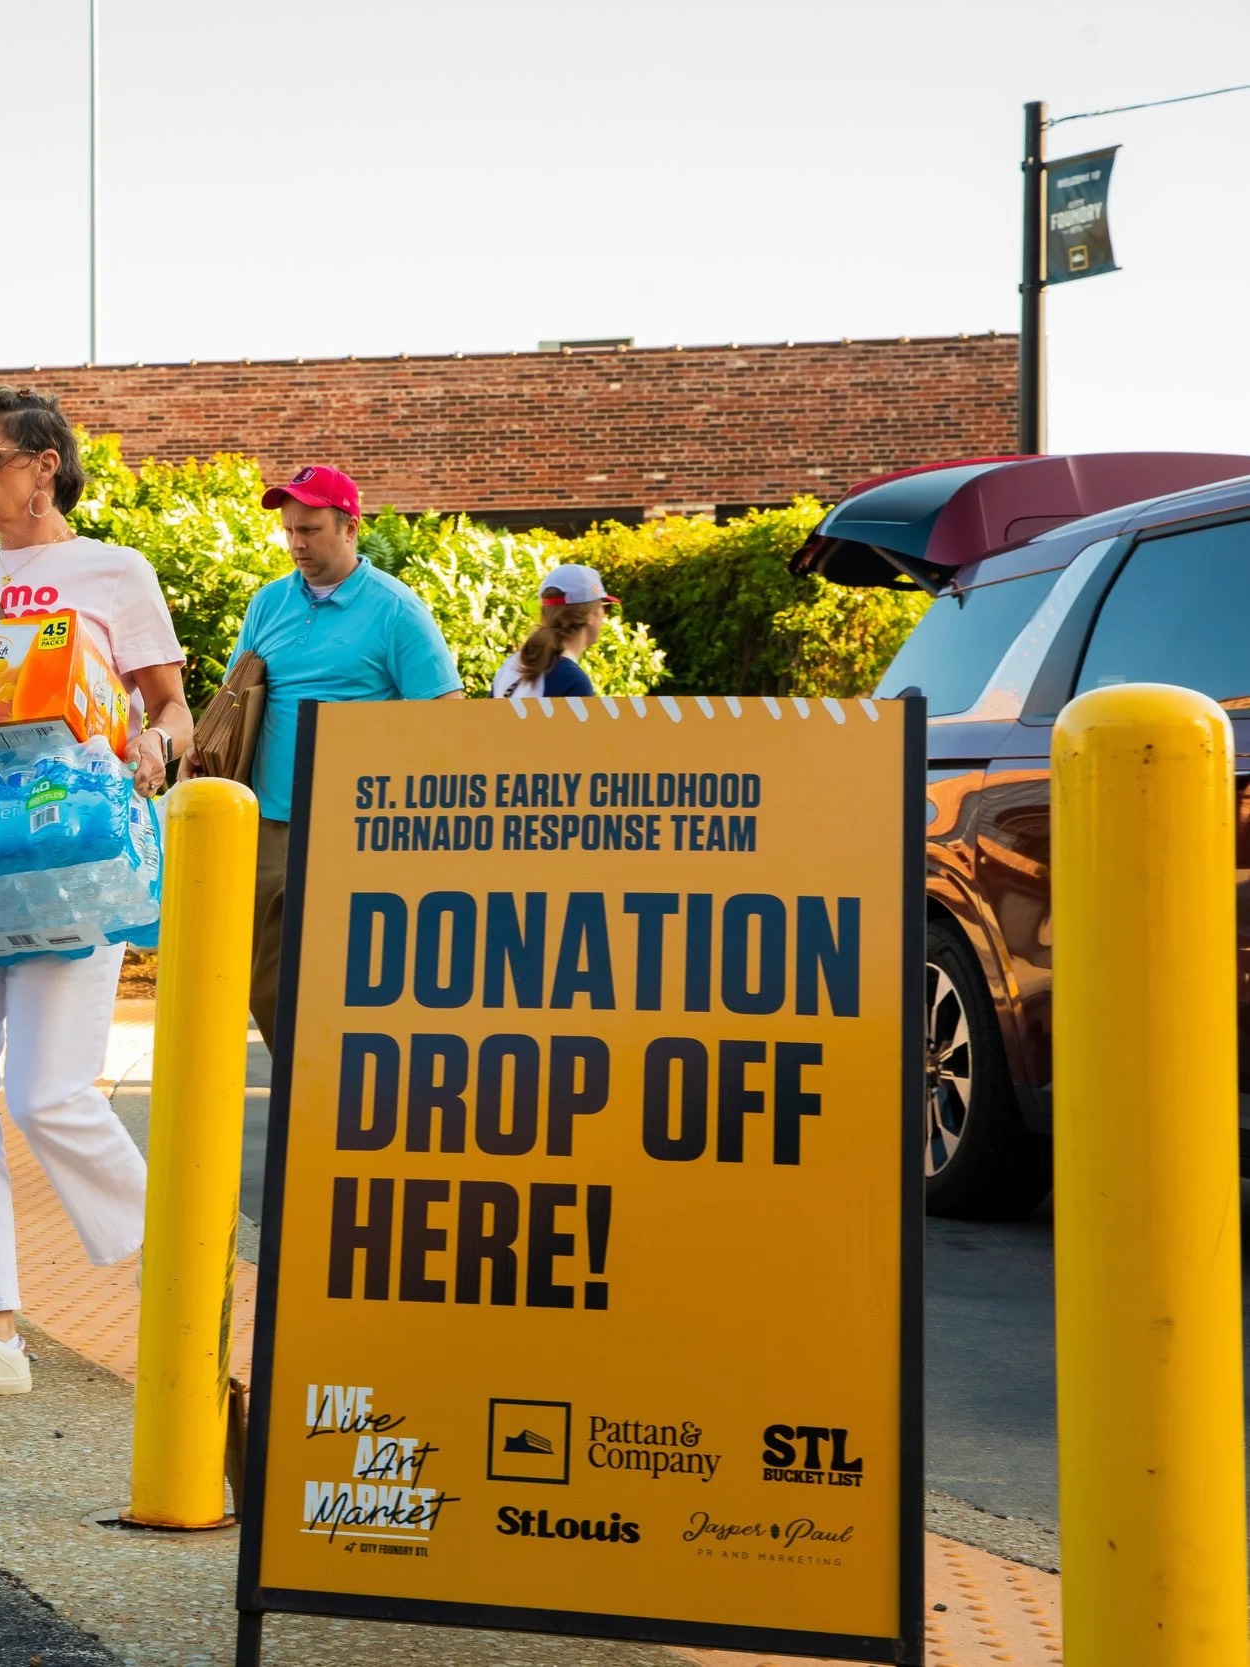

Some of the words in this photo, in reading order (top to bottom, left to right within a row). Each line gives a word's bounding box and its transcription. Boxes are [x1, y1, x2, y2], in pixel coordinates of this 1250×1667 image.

[43, 621, 67, 636] 45
[31, 780, 50, 795] 40
[356, 775, 397, 810] ST.
[405, 774, 487, 809] LOUIS
[495, 773, 582, 808] EARLY
[589, 773, 761, 808] CHILDHOOD
[355, 816, 494, 852] TORNADO
[503, 815, 660, 852] RESPONSE
[671, 816, 757, 852] TEAM
[344, 890, 861, 1018] DONATION
[336, 1032, 610, 1157] DROP
[642, 1037, 823, 1166] OFF
[327, 1177, 612, 1311] HERE!
[306, 1395, 406, 1439] Live
[357, 1442, 440, 1490] Art
[587, 1442, 723, 1483] Company
[762, 1423, 863, 1472] STL
[763, 1467, 825, 1485] BUCKET
[828, 1472, 863, 1487] LIST
[309, 1491, 461, 1544] Market
[682, 1511, 767, 1542] Jasper
[781, 1517, 854, 1548] Paul
[360, 1542, 377, 1554] CITY
[415, 1546, 429, 1557] STL
[697, 1548, 713, 1558] PR
[721, 1550, 749, 1560] AND
[758, 1552, 843, 1567] MARKETING
